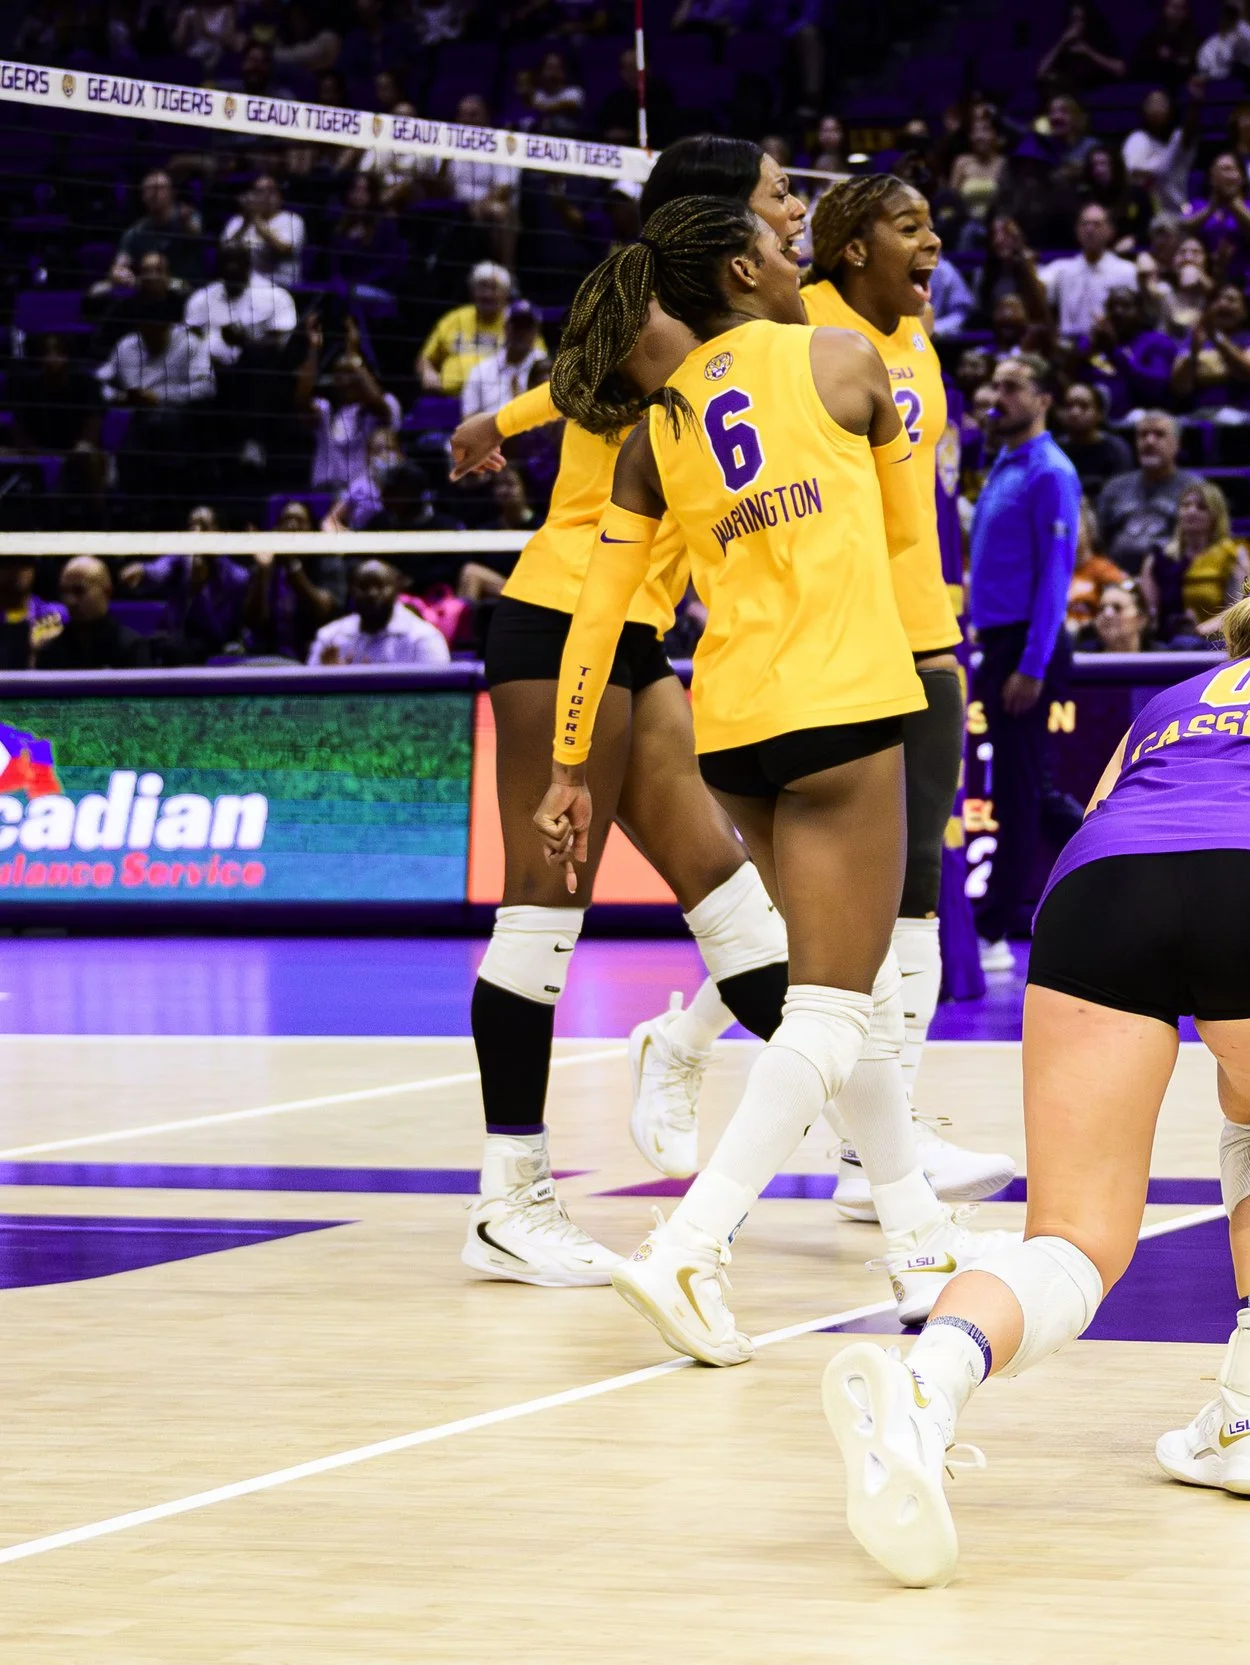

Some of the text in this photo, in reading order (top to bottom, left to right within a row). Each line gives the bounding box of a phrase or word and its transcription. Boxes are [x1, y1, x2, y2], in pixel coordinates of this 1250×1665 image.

[0, 65, 50, 95] GERS
[87, 77, 147, 108] GEAUX
[152, 86, 214, 116] TIGERS
[246, 99, 299, 129] GEAUX
[305, 107, 362, 135] TIGERS
[392, 118, 441, 146] GEAUX
[446, 126, 498, 153] TIGERS
[525, 137, 569, 162] GEAUX
[704, 386, 766, 494] 6
[564, 665, 592, 746] TIGERS
[0, 769, 269, 852] cadian
[906, 1256, 936, 1268] LSU
